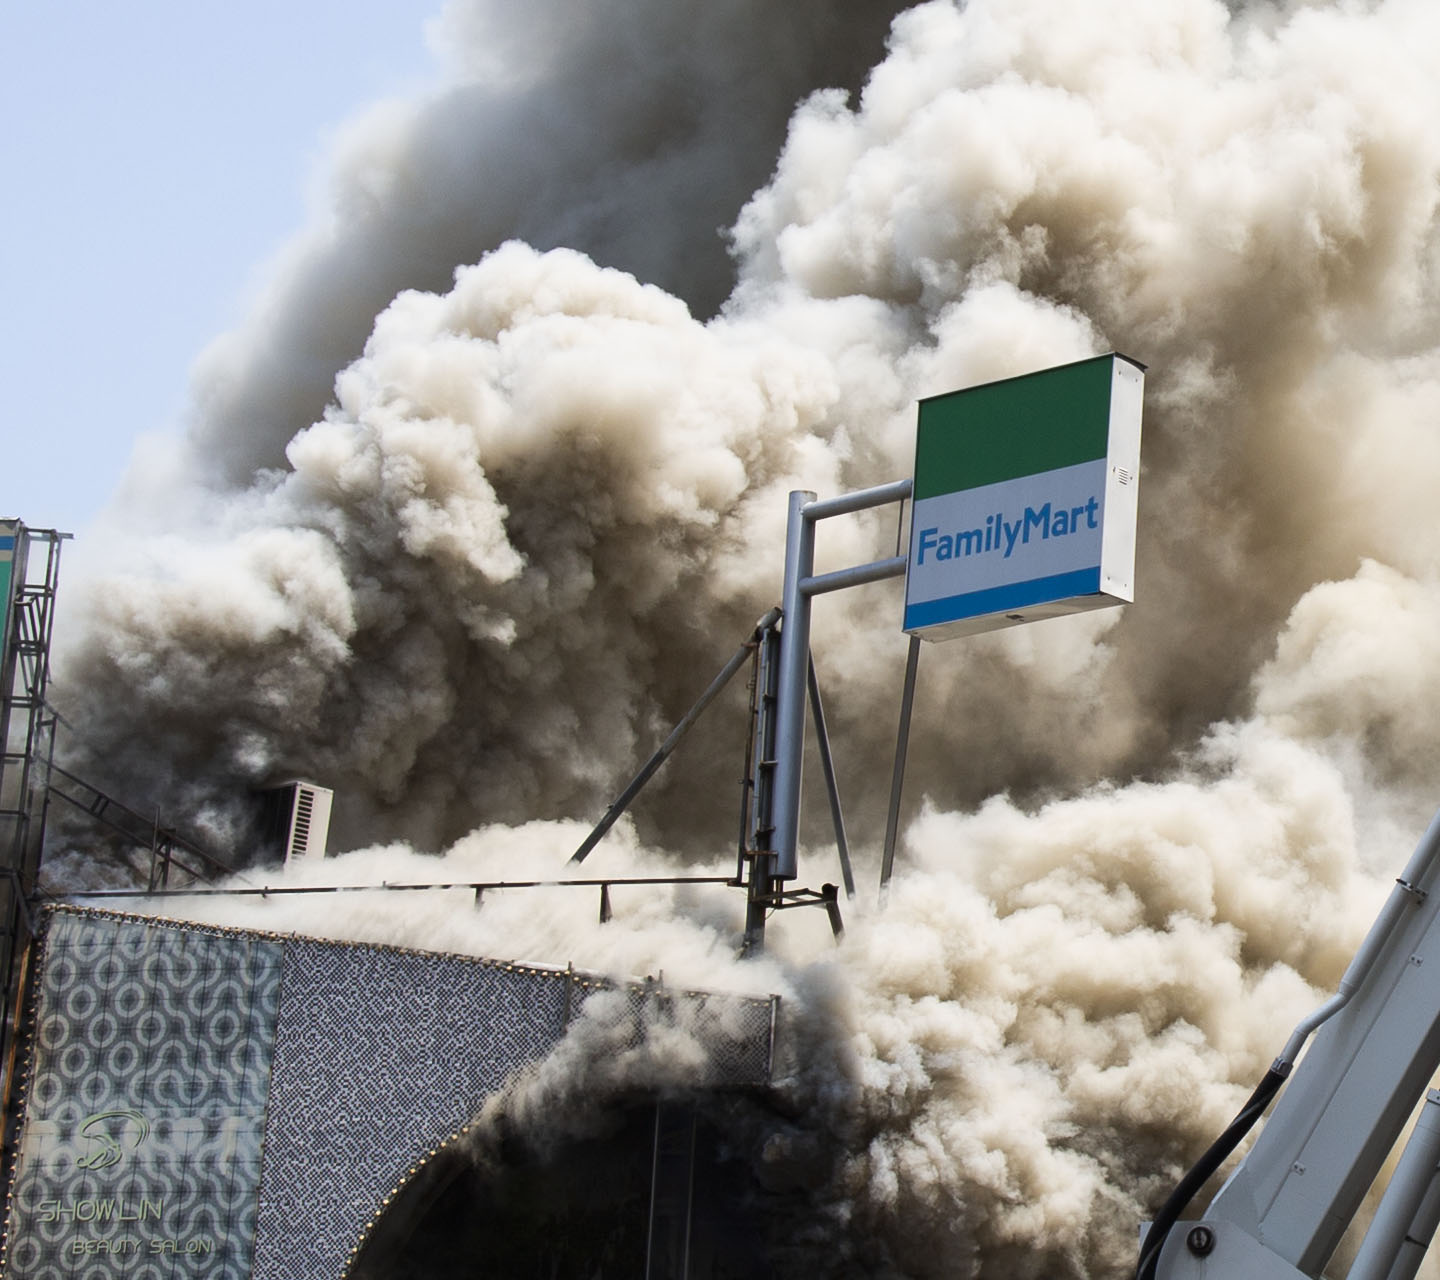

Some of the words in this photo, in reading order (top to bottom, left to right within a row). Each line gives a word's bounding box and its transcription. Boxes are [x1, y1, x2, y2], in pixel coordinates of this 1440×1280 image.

[916, 496, 1099, 567] FamilyMart
[36, 1199, 115, 1223] SHOW
[120, 1199, 163, 1221] LIN
[72, 1239, 142, 1255] BEAUTY
[150, 1239, 213, 1254] SALON
